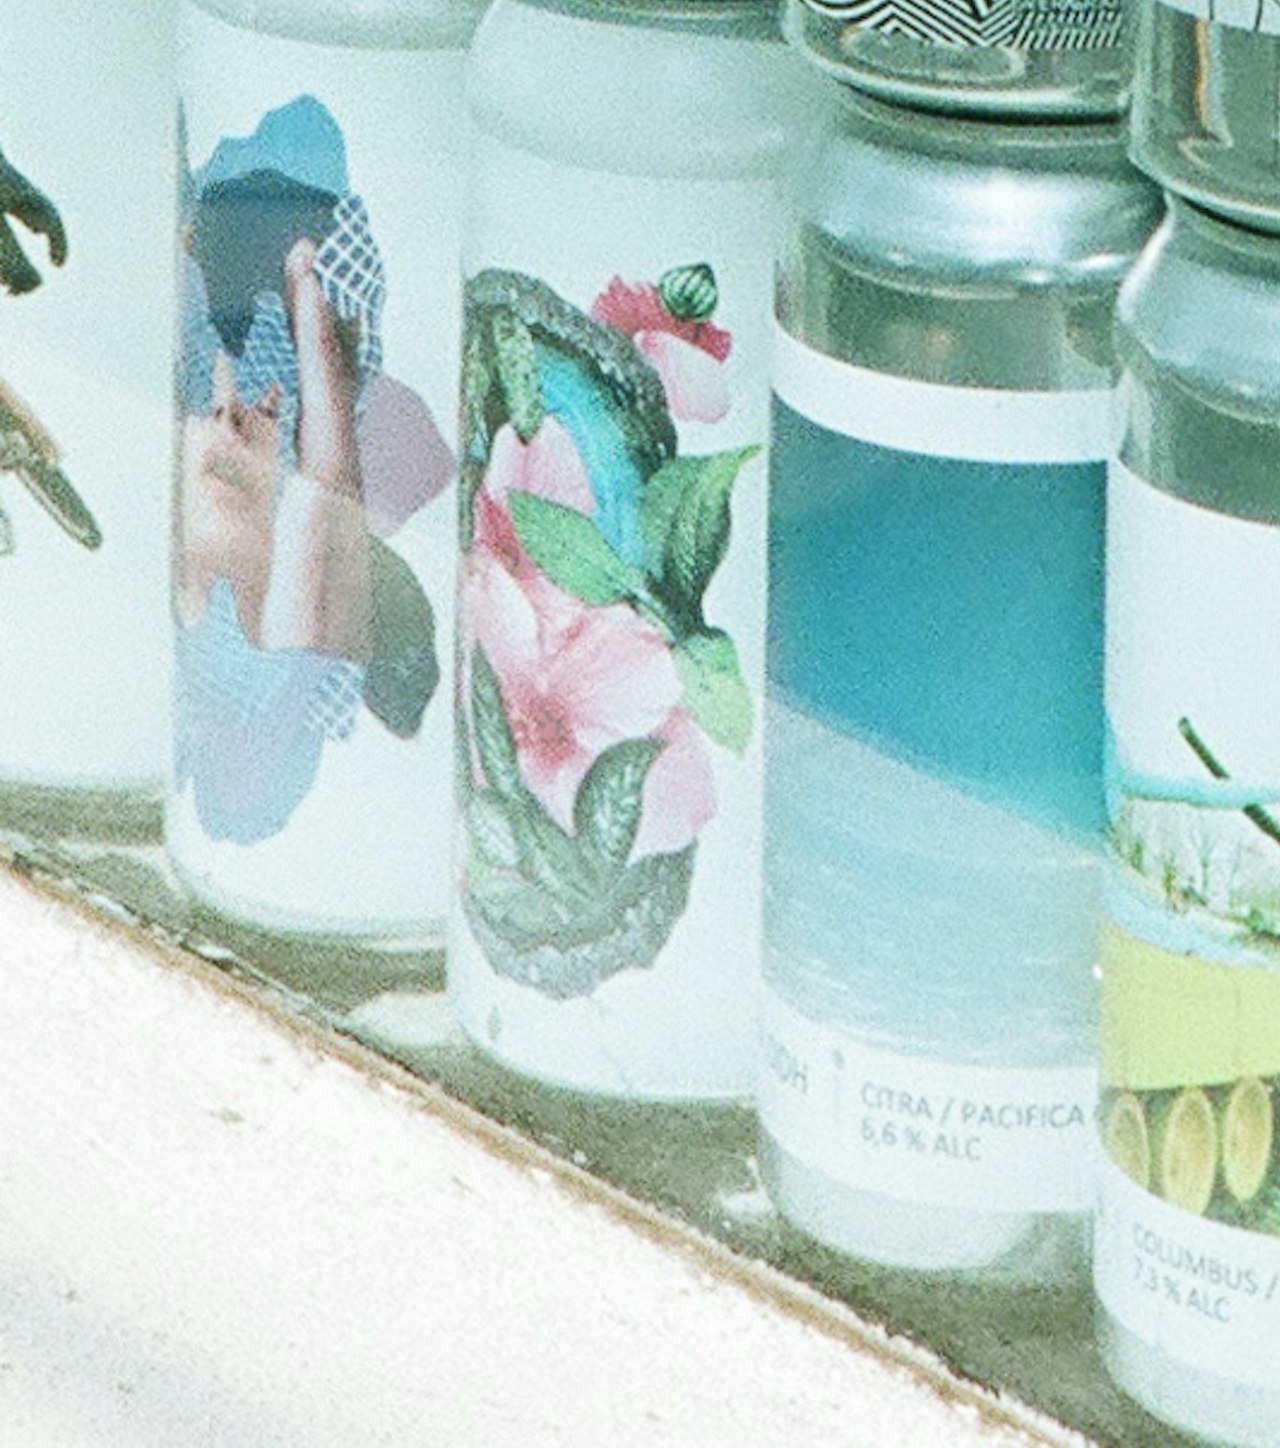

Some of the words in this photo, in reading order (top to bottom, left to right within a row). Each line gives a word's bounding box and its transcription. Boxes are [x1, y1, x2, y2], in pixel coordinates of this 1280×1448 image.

[861, 1081, 933, 1122] CITRA
[962, 1099, 1086, 1131] PACIFICA
[932, 1132, 982, 1163] ALC
[1187, 1284, 1231, 1324] ALC
